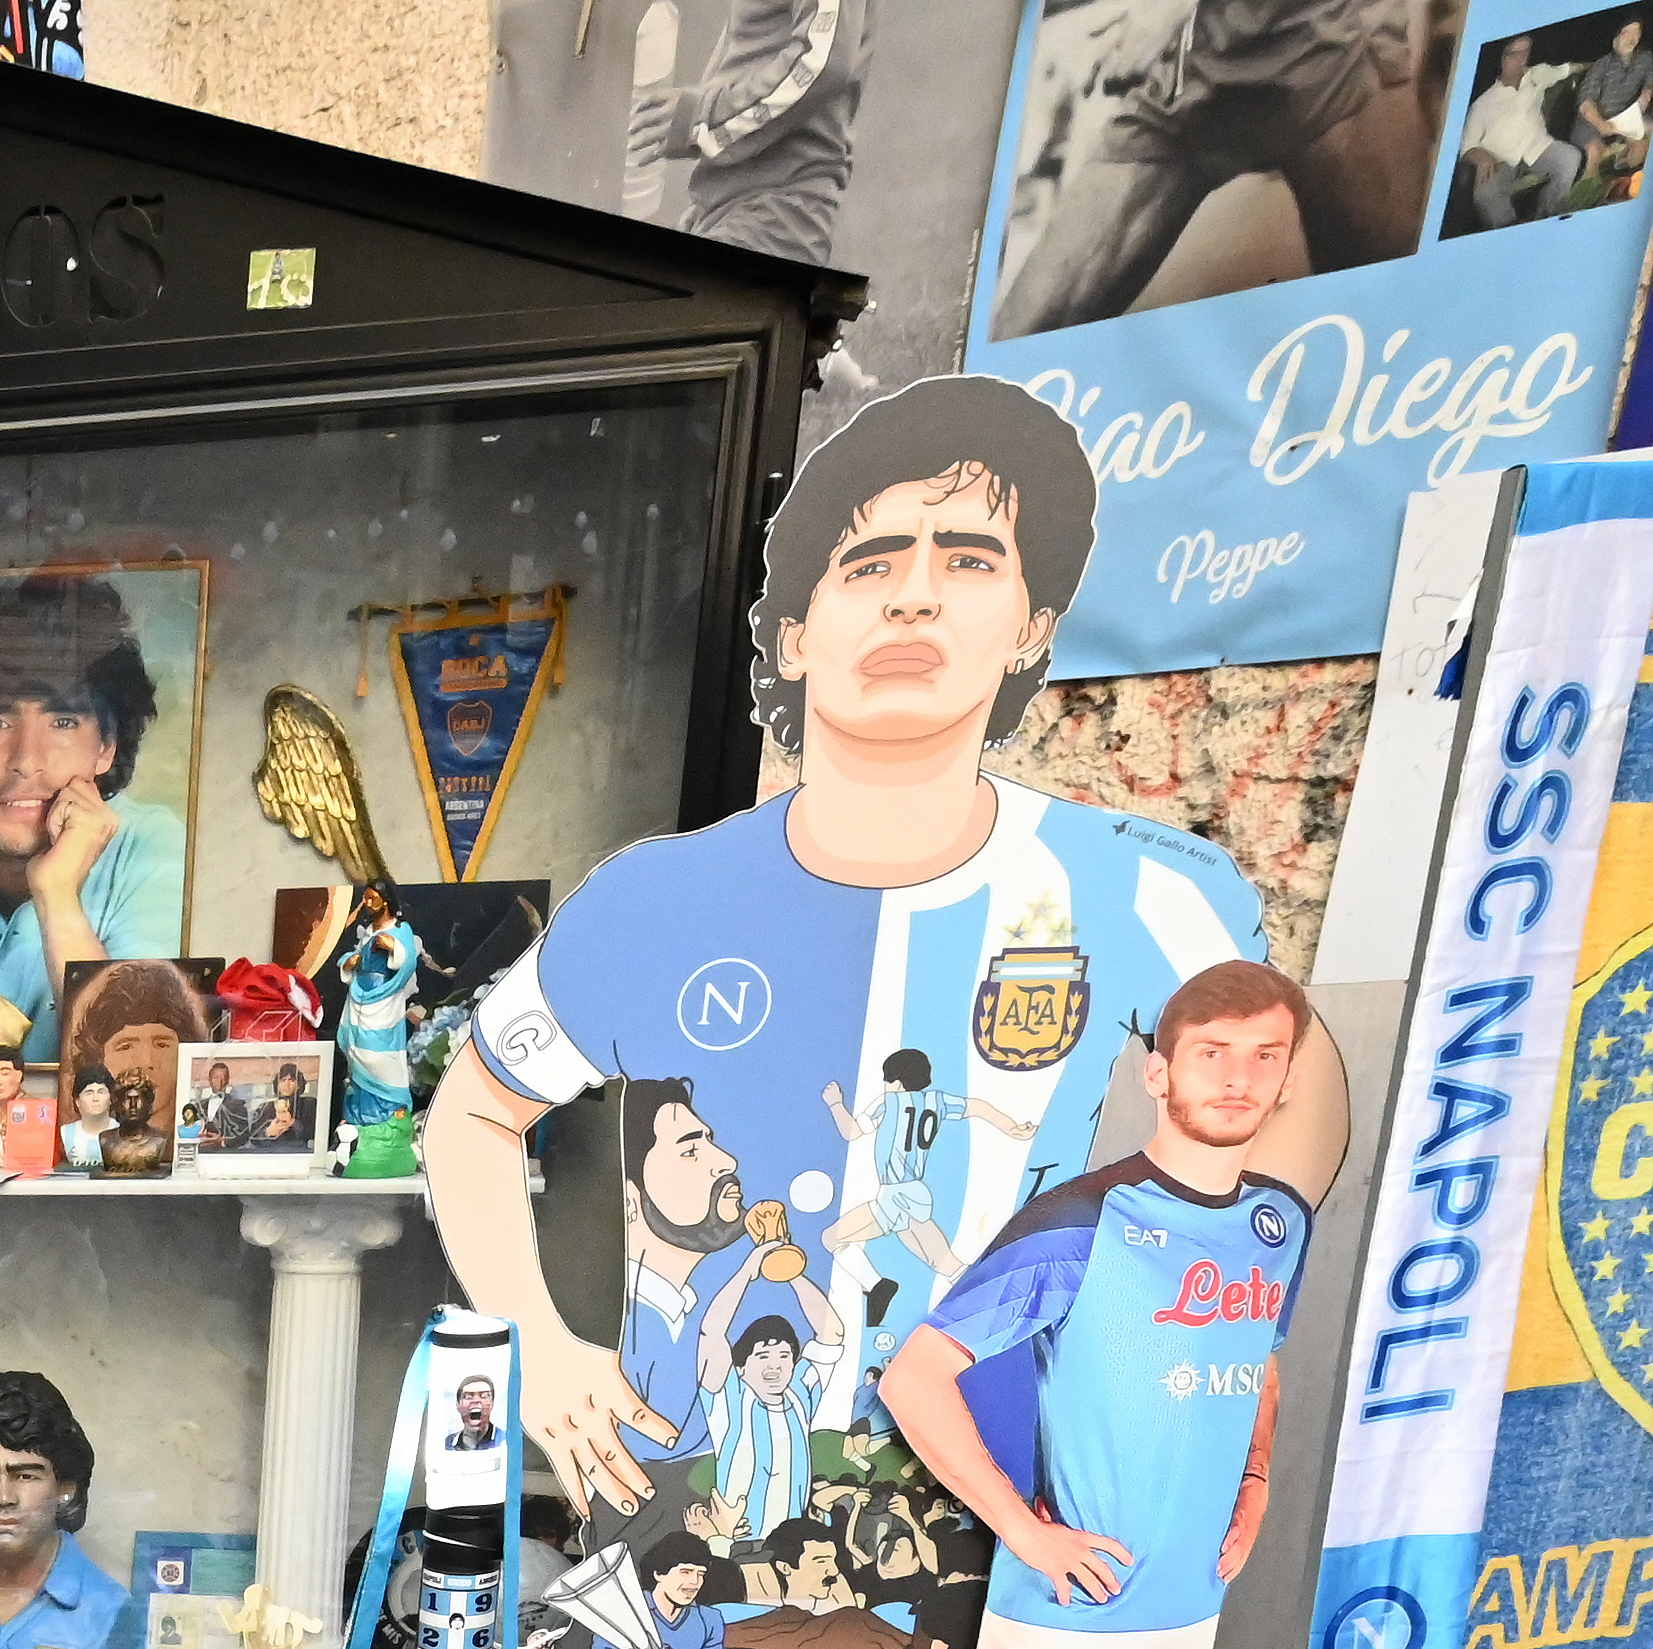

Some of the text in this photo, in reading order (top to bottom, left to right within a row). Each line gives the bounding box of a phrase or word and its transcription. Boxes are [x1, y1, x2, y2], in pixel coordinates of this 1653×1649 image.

[1248, 315, 1592, 487] Diego
[1157, 529, 1305, 604] Peppe
[1126, 822, 1218, 866] Luigi Gallo Artist
[1359, 683, 1591, 1428] SSC NAPOLI
[904, 1103, 938, 1152] 10
[1154, 1259, 1283, 1324] Lete
[475, 1593, 493, 1613] 9
[422, 1627, 490, 1648] 2 6
